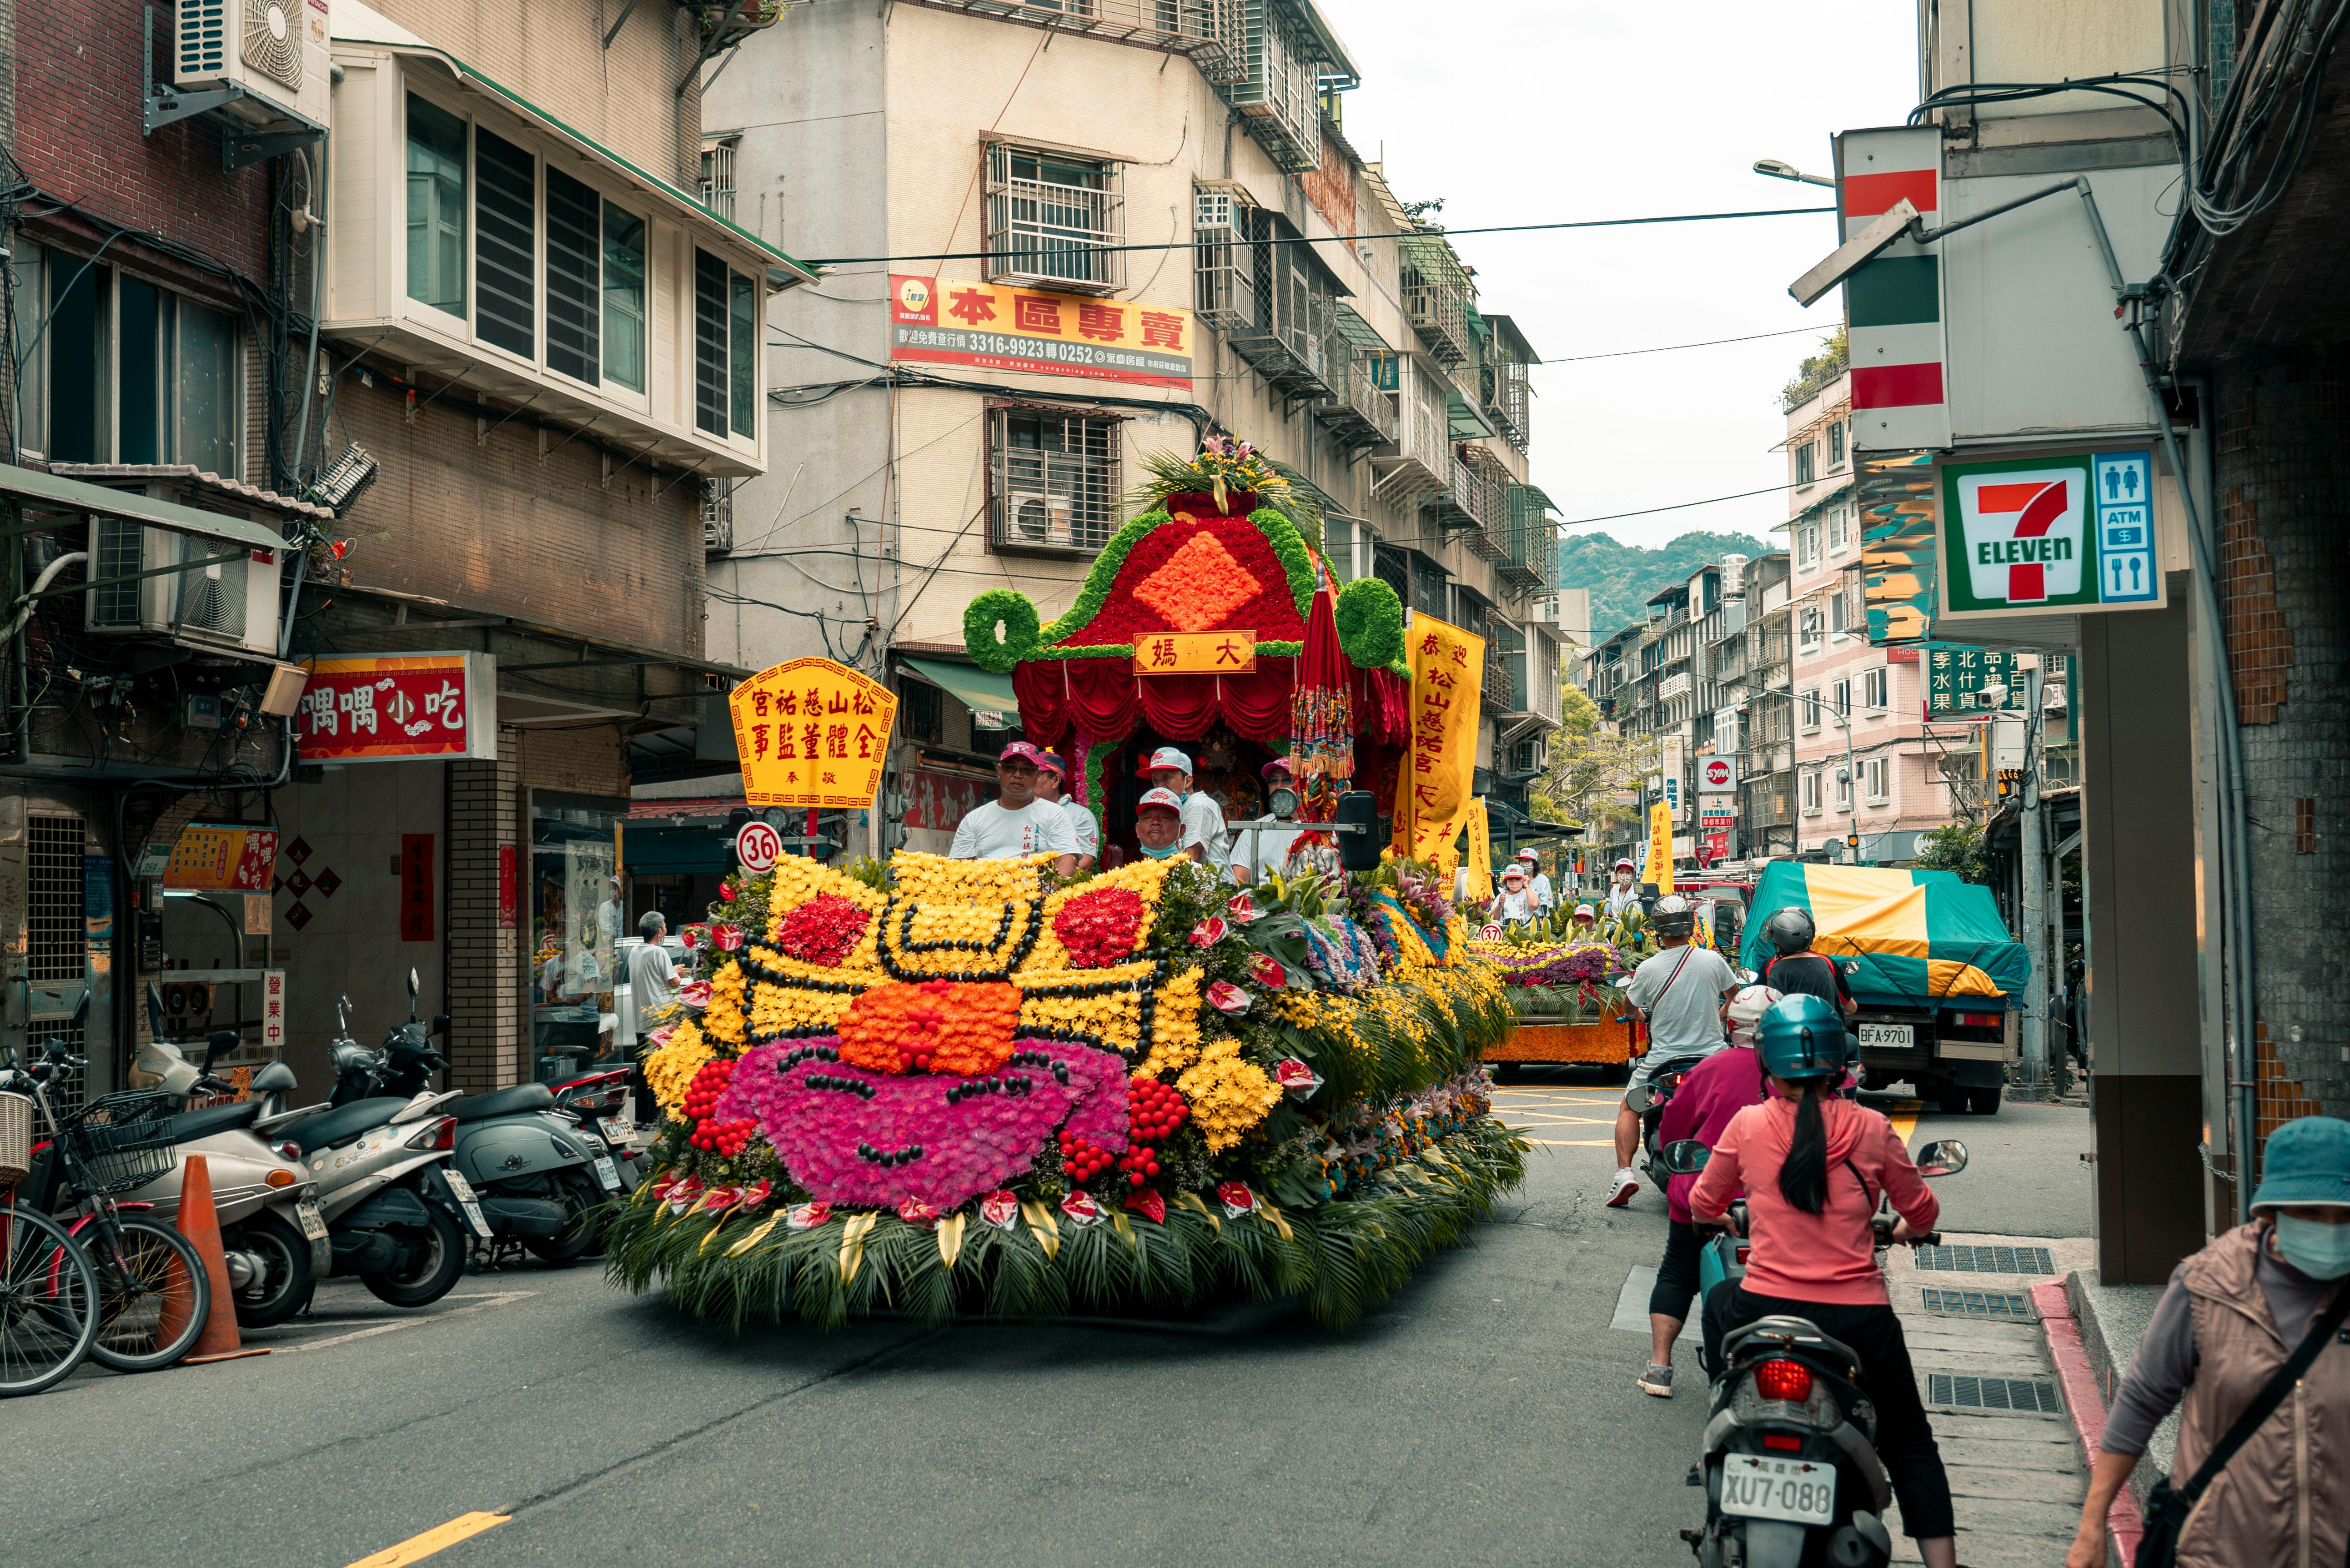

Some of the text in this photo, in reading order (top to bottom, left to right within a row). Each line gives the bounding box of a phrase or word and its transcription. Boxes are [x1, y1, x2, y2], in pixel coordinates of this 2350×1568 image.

[948, 288, 1185, 351] 本區專賣
[899, 329, 965, 347] 歡迎免費查行情
[970, 333, 1044, 358] 3316-9923
[1046, 342, 1057, 359] 轉
[1059, 343, 1093, 364] 0252
[1106, 353, 1145, 367] 永慶房屋
[1040, 366, 1119, 378] yungching.com.tw
[2108, 511, 2141, 524] ATM
[1977, 480, 2068, 600] 7
[1419, 633, 1467, 668] 恭迎
[1933, 652, 1950, 710] 季水果
[1958, 651, 1977, 709] 北什貨
[301, 680, 463, 736] 喁喁小吃
[752, 688, 877, 717] 松山慈祐宮
[1415, 667, 1457, 774] 松山慈祐宮
[1705, 768, 1729, 780] SYM
[746, 832, 773, 861] 36
[1429, 823, 1452, 864] 平安
[1485, 930, 1498, 940] 37
[268, 976, 281, 1042] 營業中
[1861, 1030, 1910, 1044] BFA-9701
[1757, 1461, 1801, 1474] 高雄市
